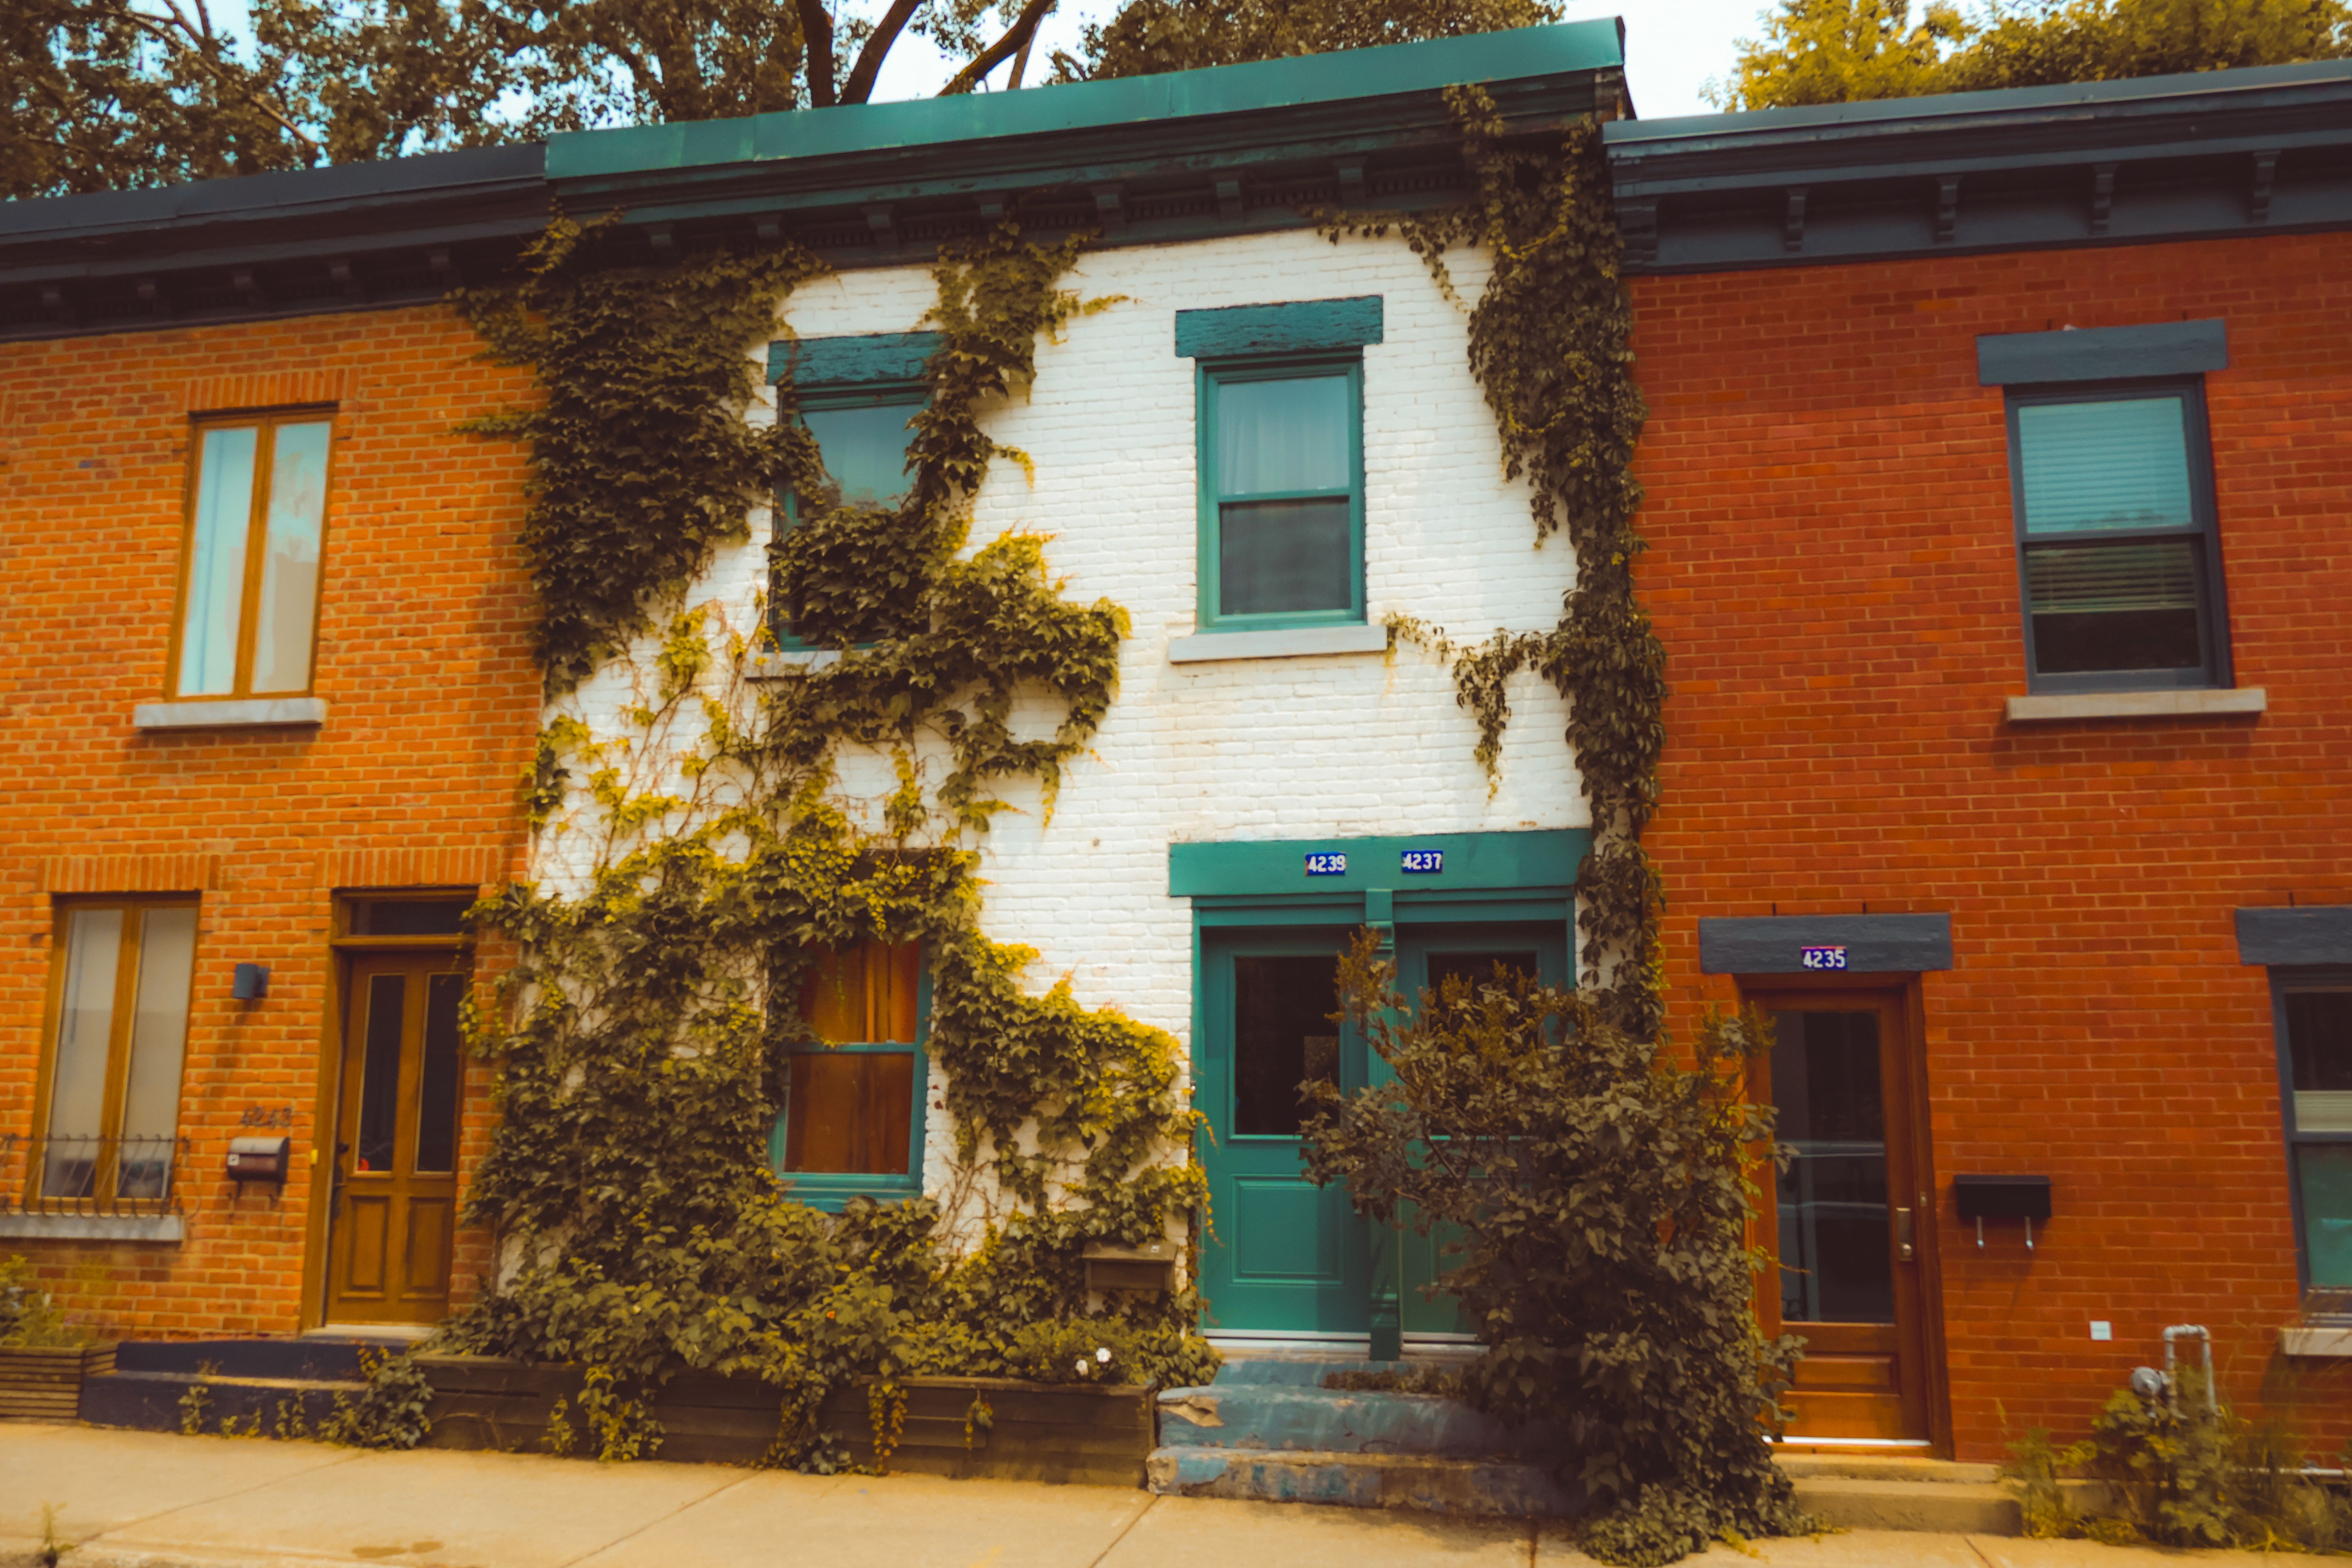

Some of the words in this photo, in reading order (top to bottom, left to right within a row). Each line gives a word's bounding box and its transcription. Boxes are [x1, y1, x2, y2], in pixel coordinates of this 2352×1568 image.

[1308, 855, 1346, 872] 4239
[1403, 853, 1442, 869] 4237
[1803, 949, 1846, 968] 4235
